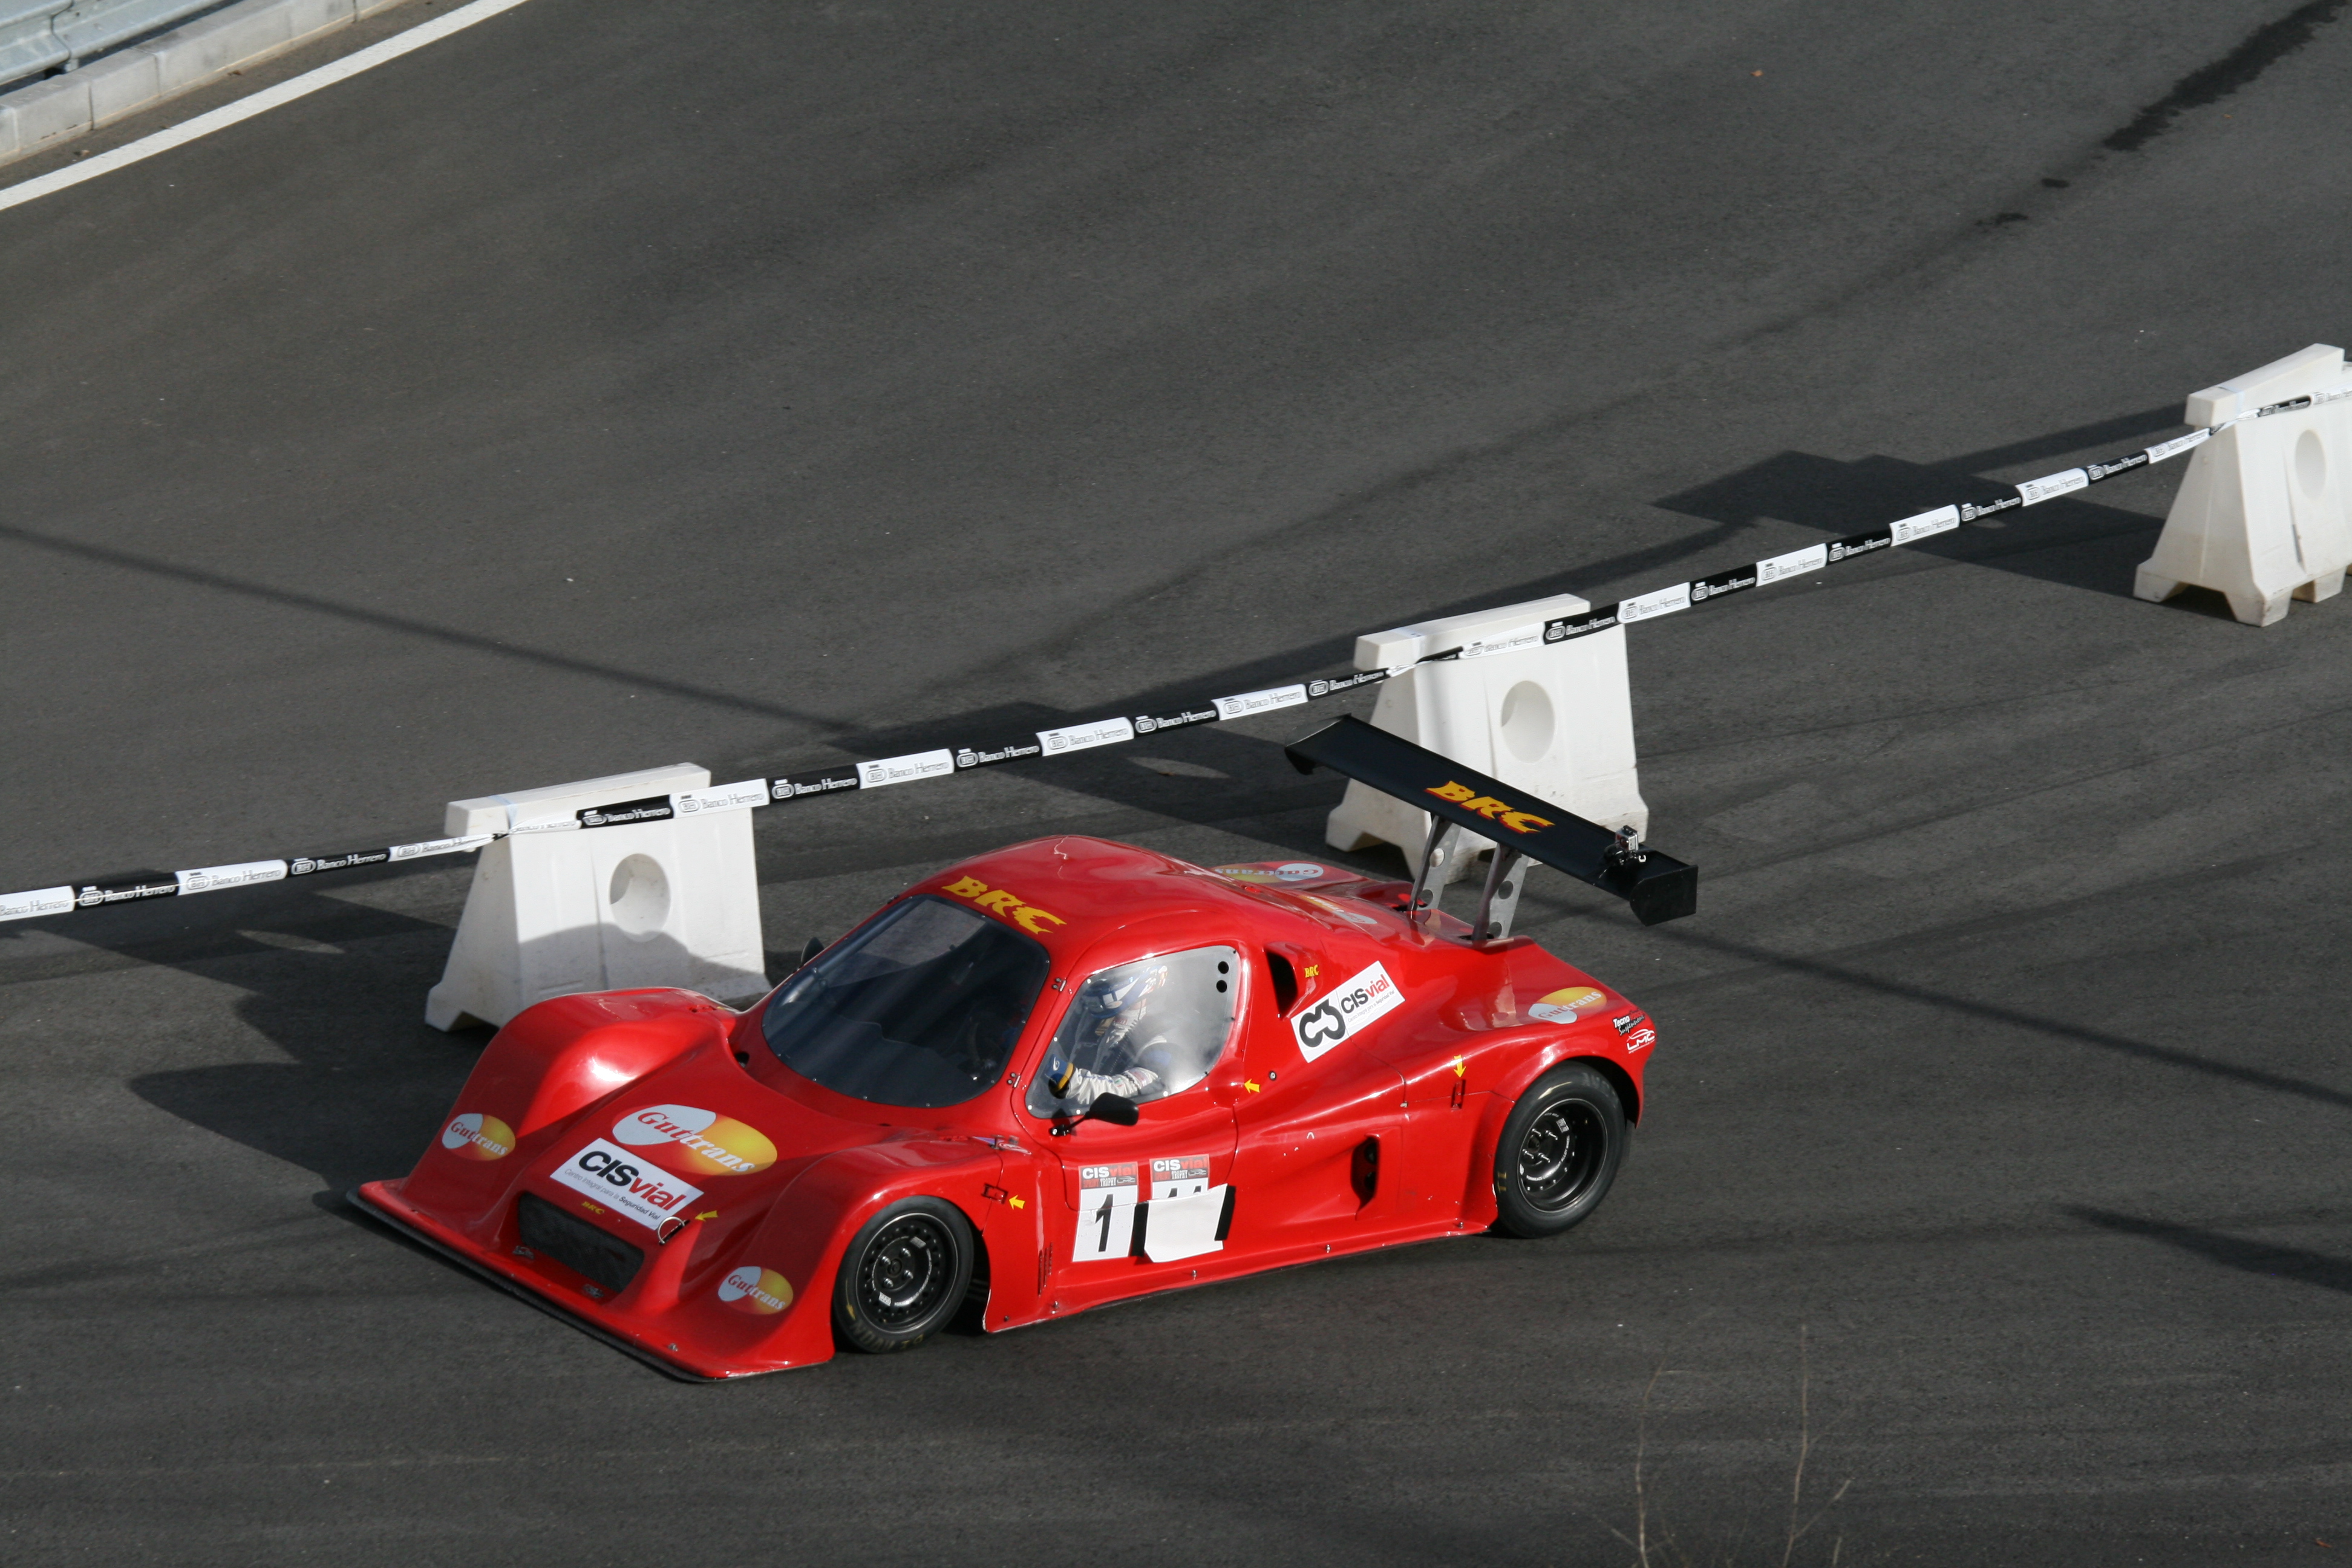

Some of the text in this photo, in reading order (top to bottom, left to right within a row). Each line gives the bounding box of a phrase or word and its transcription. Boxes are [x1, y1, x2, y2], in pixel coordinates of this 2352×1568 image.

[1423, 780, 1555, 834] BRC
[242, 869, 281, 881] Herrero
[316, 859, 346, 871] Banco
[347, 854, 386, 866] Herrero
[941, 875, 1067, 935] BRC
[1304, 964, 1319, 978] BRC
[1341, 974, 1390, 1013] CISvial
[1538, 991, 1602, 1019] Guttrans
[1613, 1016, 1630, 1028] Tecno
[1627, 1033, 1655, 1050] LMC
[451, 1122, 508, 1155] Guttrans
[638, 1112, 756, 1172] Guttrans
[1082, 1165, 1136, 1179] CISvial
[1154, 1157, 1207, 1172] CISvial
[579, 1151, 687, 1210] CISvial
[581, 1201, 604, 1214] BRC
[619, 1197, 649, 1214] Seguridad
[648, 1210, 661, 1220] Vial
[1094, 1194, 1114, 1252] 1
[728, 1275, 785, 1310] Guttrans
